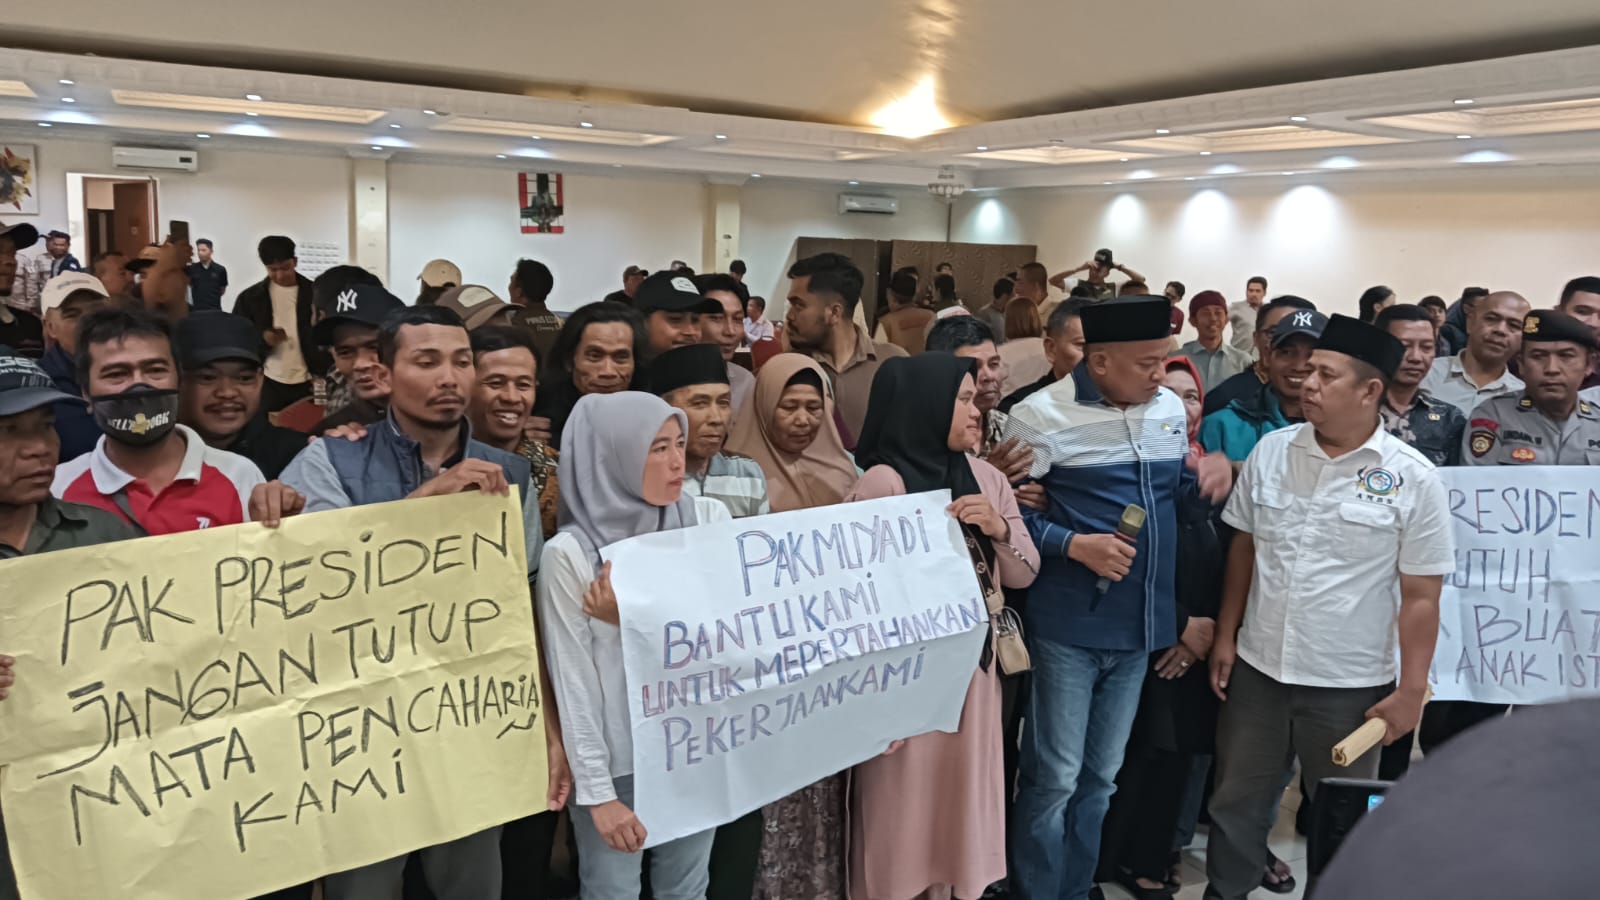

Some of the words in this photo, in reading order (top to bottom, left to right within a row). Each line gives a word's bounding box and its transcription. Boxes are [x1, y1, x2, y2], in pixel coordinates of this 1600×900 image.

[336, 288, 358, 313] NY
[1292, 311, 1313, 327] NY
[1449, 486, 1600, 539] RESIDEN
[62, 575, 196, 665] PAK
[214, 510, 509, 635] PRESiDEN
[736, 530, 817, 597] PAK
[1443, 548, 1550, 603] UTUH
[641, 665, 746, 718] UNTUK
[754, 596, 982, 688] MEPERTAHANKAN
[663, 598, 797, 670] BANTU
[1473, 604, 1600, 655] BUAT
[36, 632, 318, 780] JANGAN
[331, 598, 502, 679] TUTUP
[1455, 644, 1548, 687] ANAK
[69, 726, 256, 847] MATA
[233, 747, 407, 853] KAMi
